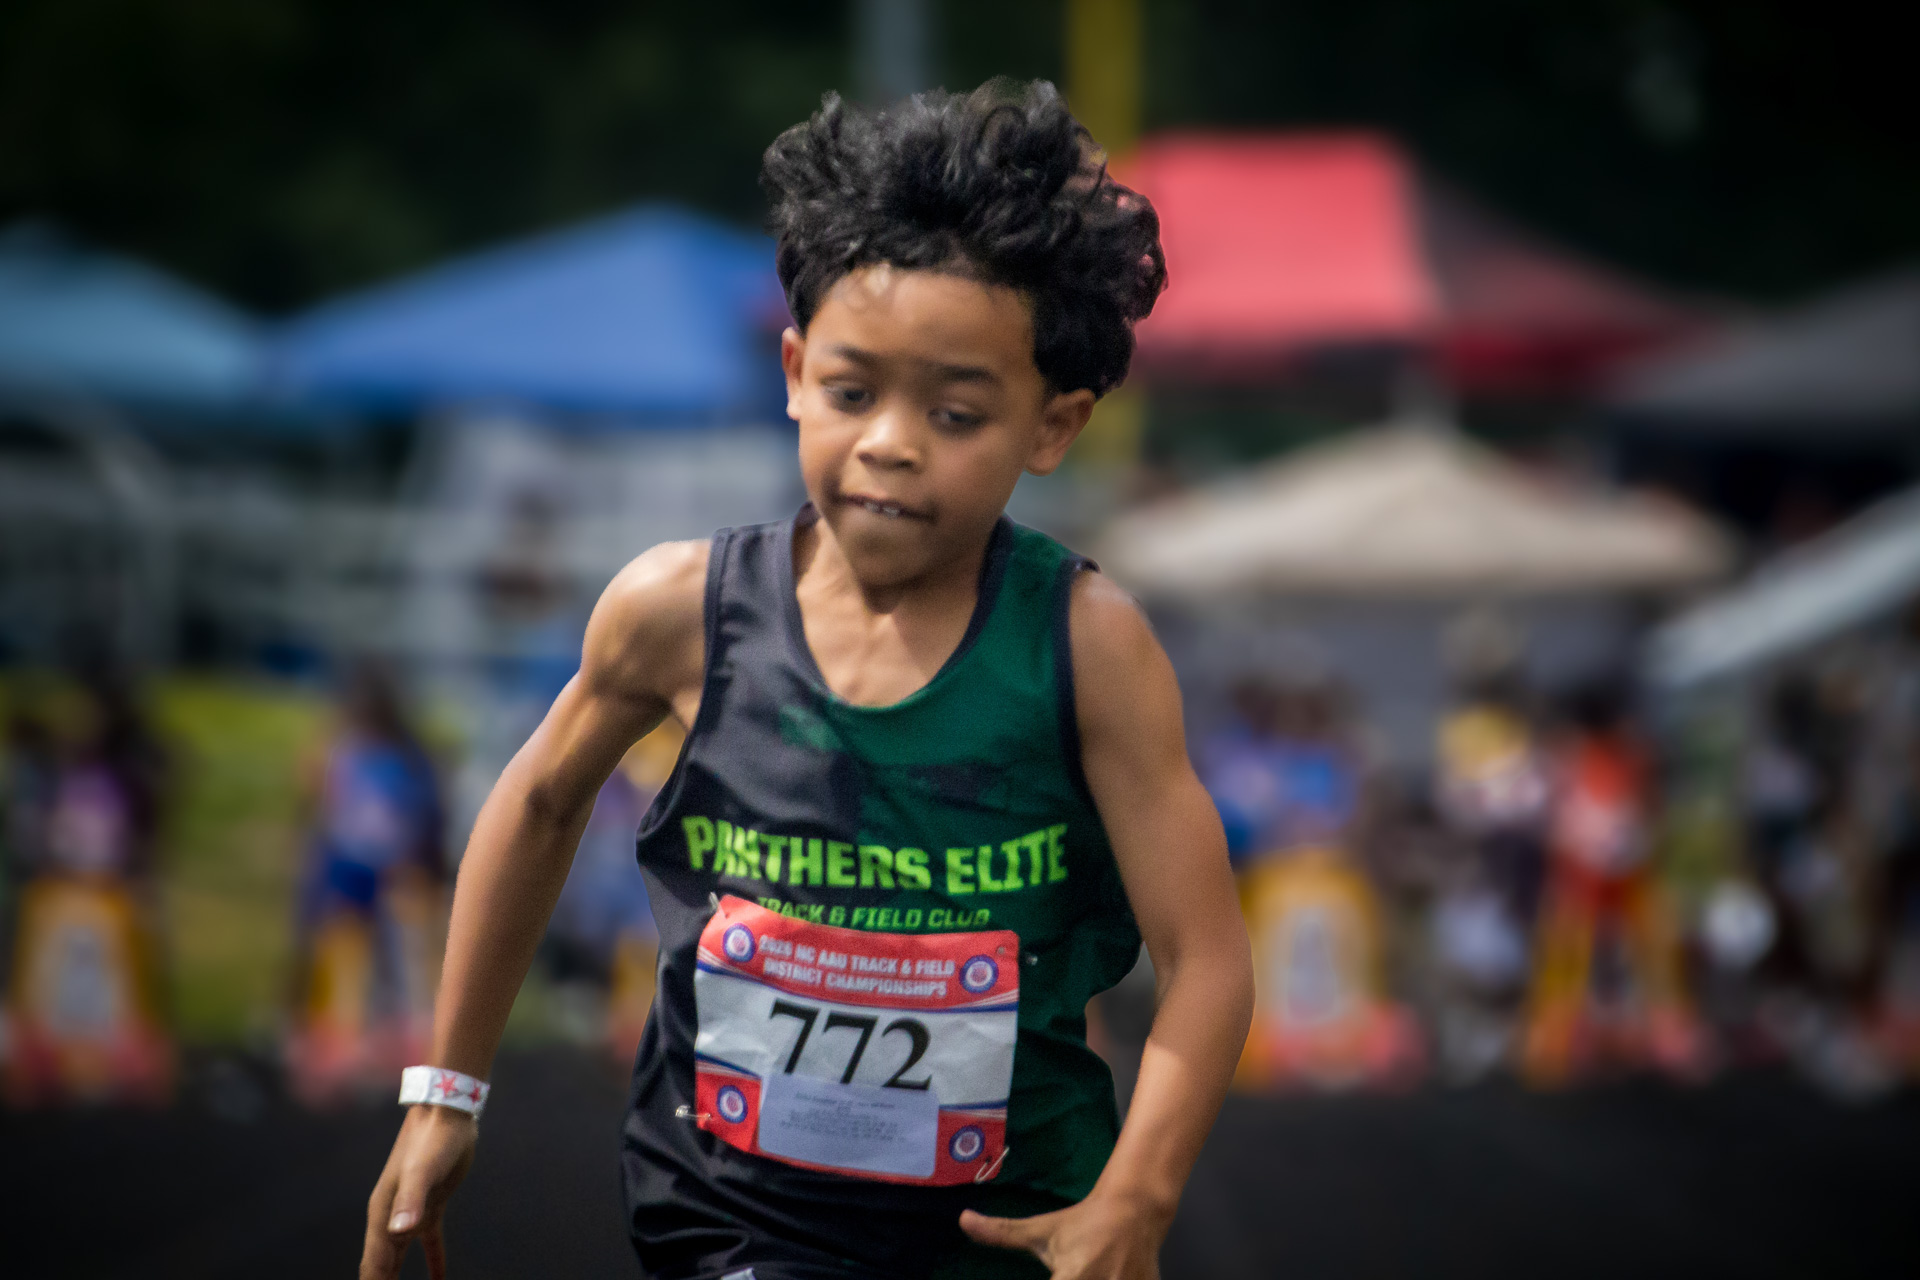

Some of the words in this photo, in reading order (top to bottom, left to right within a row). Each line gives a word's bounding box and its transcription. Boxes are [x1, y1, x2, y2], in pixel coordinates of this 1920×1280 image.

[681, 815, 932, 890] PANTHERS
[945, 823, 1068, 895] ELITE
[852, 907, 922, 929] FIELD
[928, 908, 991, 929] CLUB
[763, 957, 823, 987] DISTRICT
[825, 972, 948, 997] CHAMPIONSHIPS
[795, 944, 816, 963] NC
[817, 950, 847, 969] AAU
[850, 955, 897, 974] TRACK
[899, 959, 911, 974] &
[915, 959, 955, 976] FIELD
[770, 998, 932, 1092] 772
